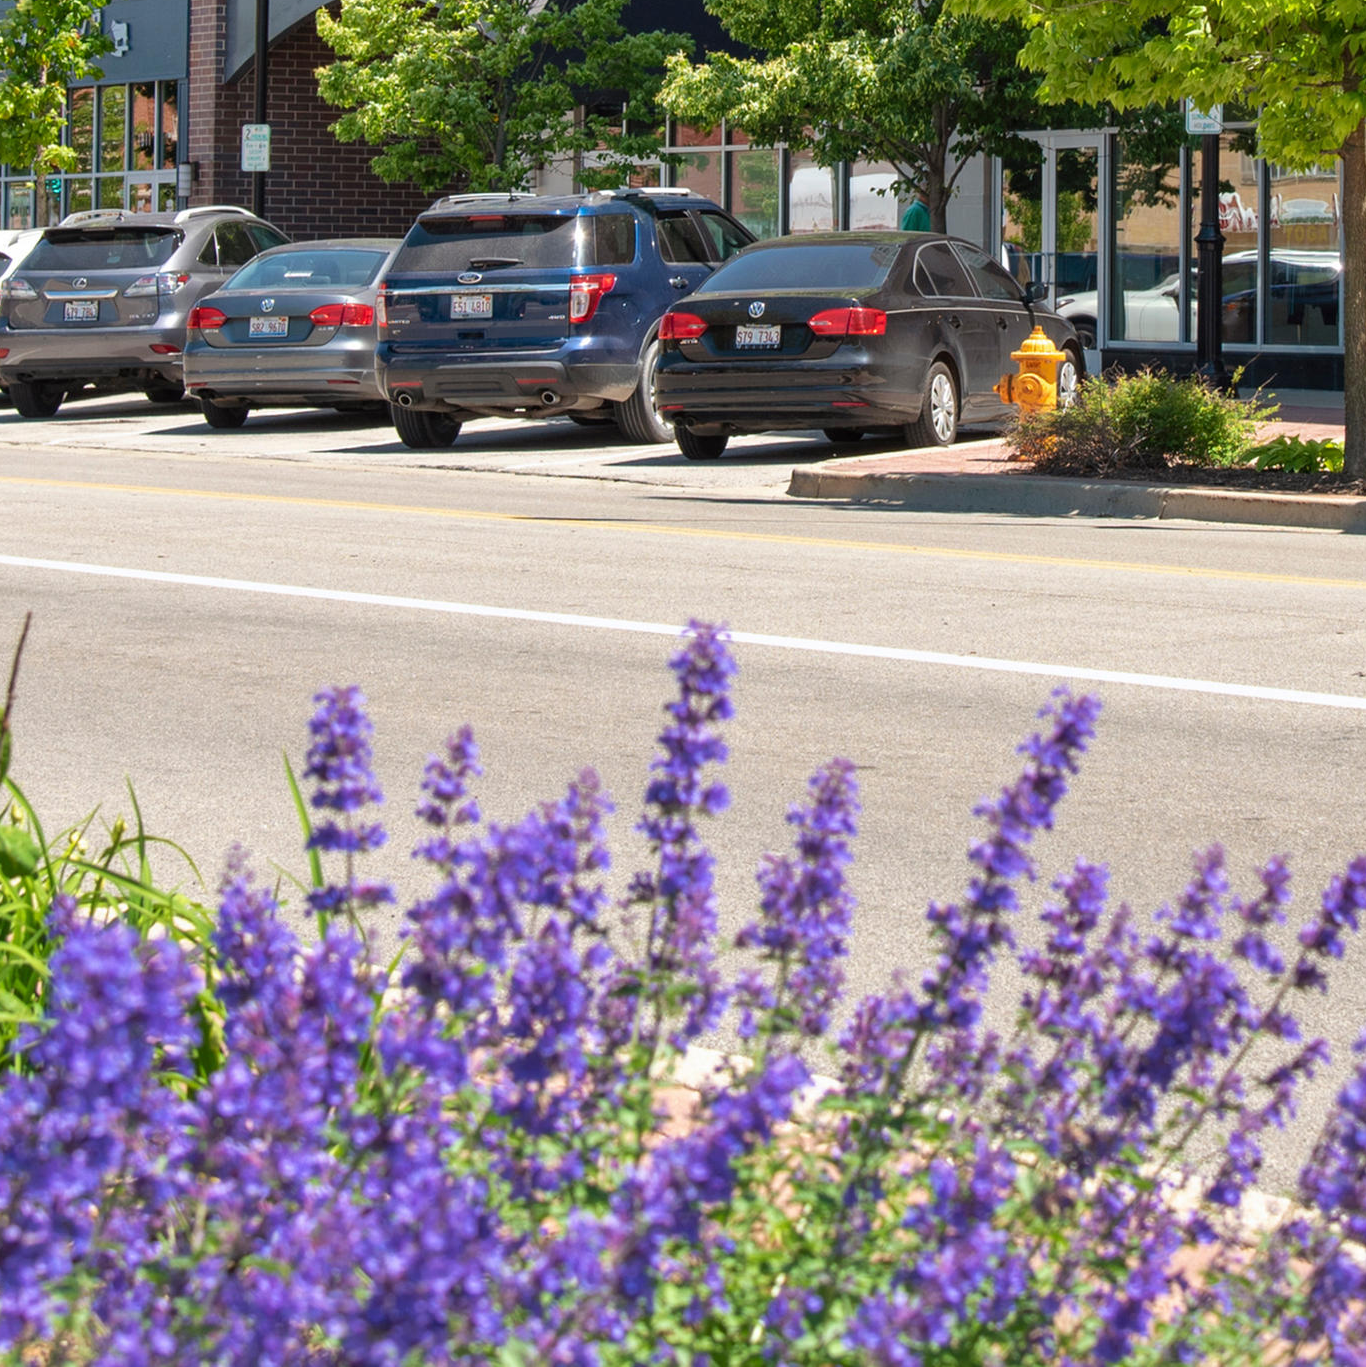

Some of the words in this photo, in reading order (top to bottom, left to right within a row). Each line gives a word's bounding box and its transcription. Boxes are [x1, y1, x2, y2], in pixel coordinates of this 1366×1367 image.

[1285, 226, 1327, 242] YOGA
[737, 331, 753, 344] S79
[758, 331, 780, 344] 7343
